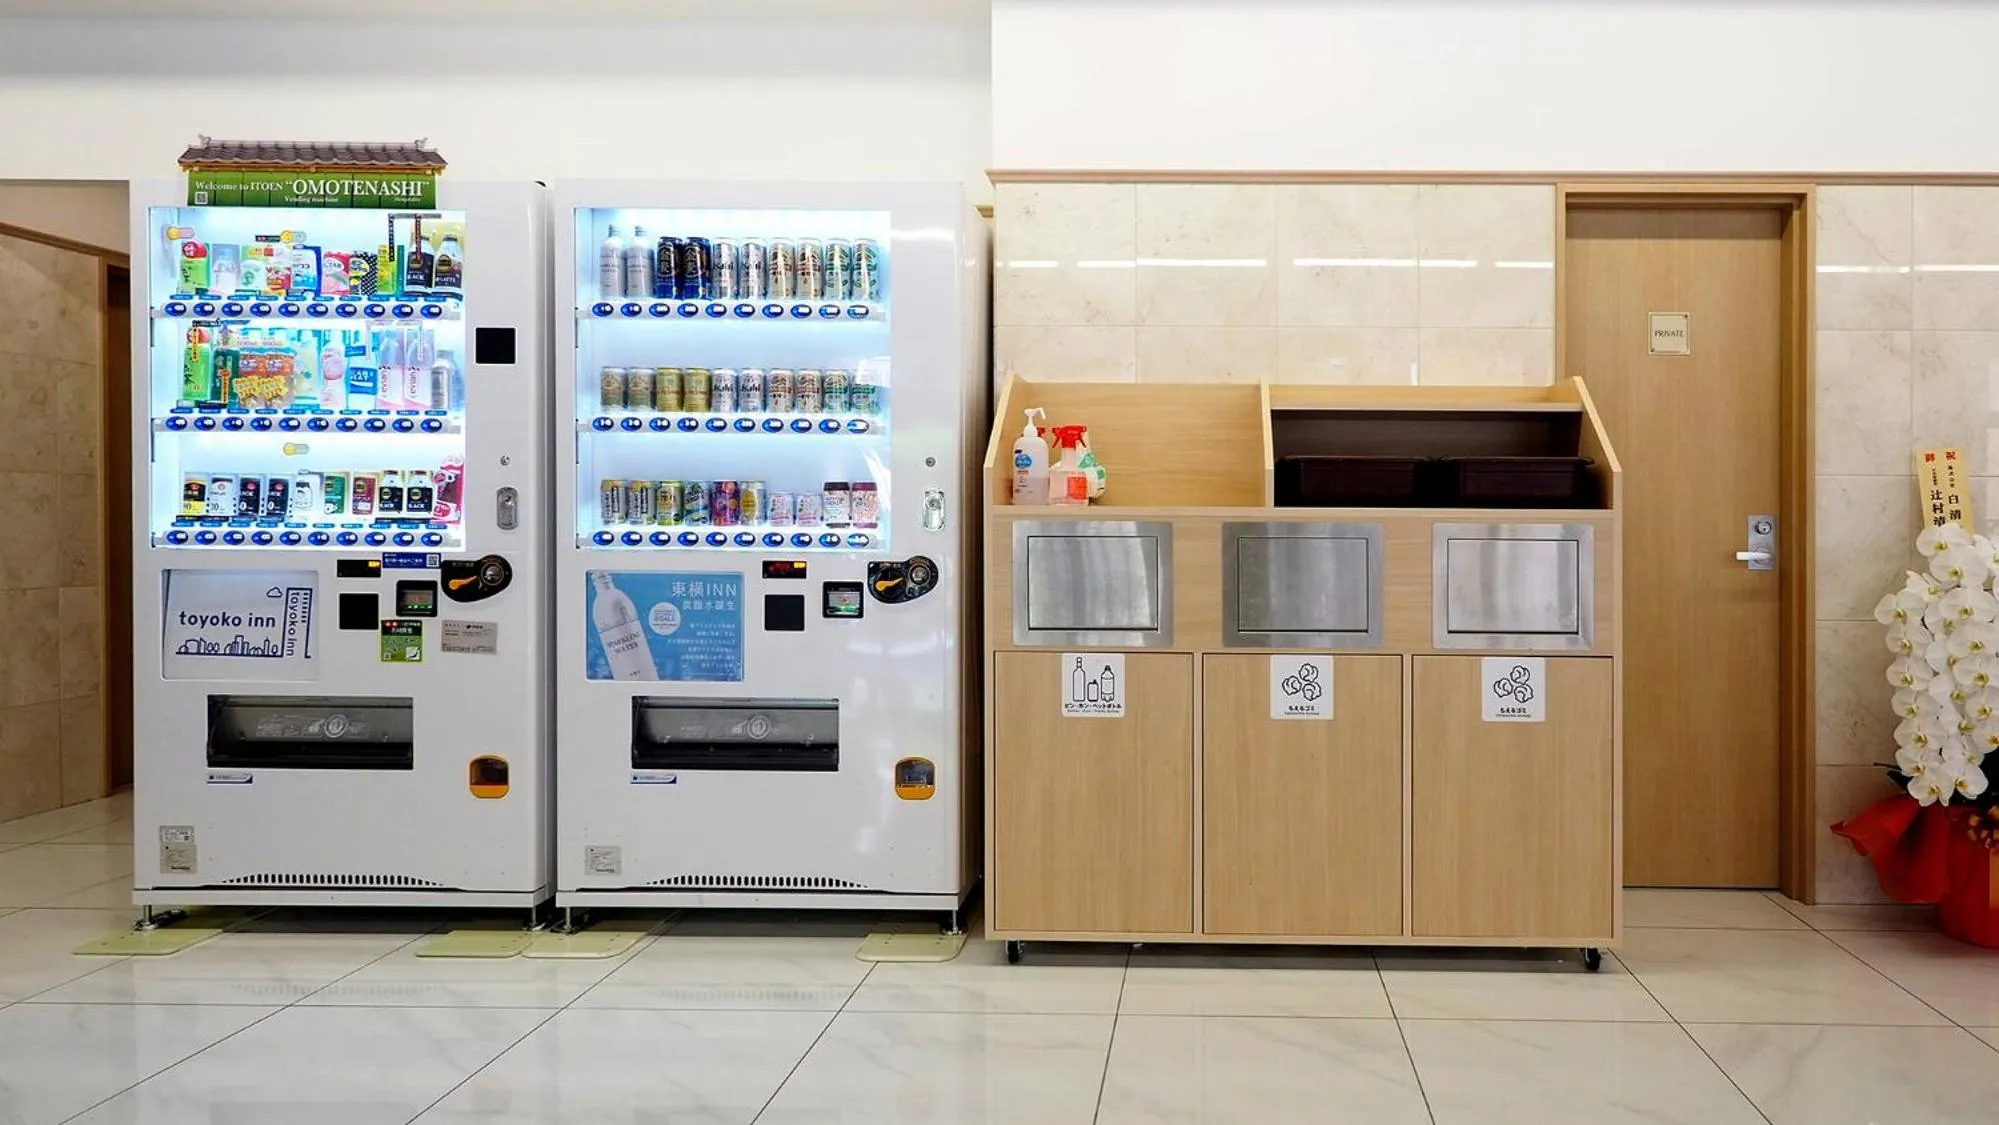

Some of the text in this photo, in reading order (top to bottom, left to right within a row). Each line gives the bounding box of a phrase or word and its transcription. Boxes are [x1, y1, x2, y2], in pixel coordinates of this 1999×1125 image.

[195, 181, 237, 191] Welcome
[239, 183, 249, 191] to
[250, 182, 283, 191] ITOEN
[1654, 330, 1684, 338] PRIVATE
[179, 611, 276, 629] toyoko inn
[286, 592, 300, 657] toyoko inn
